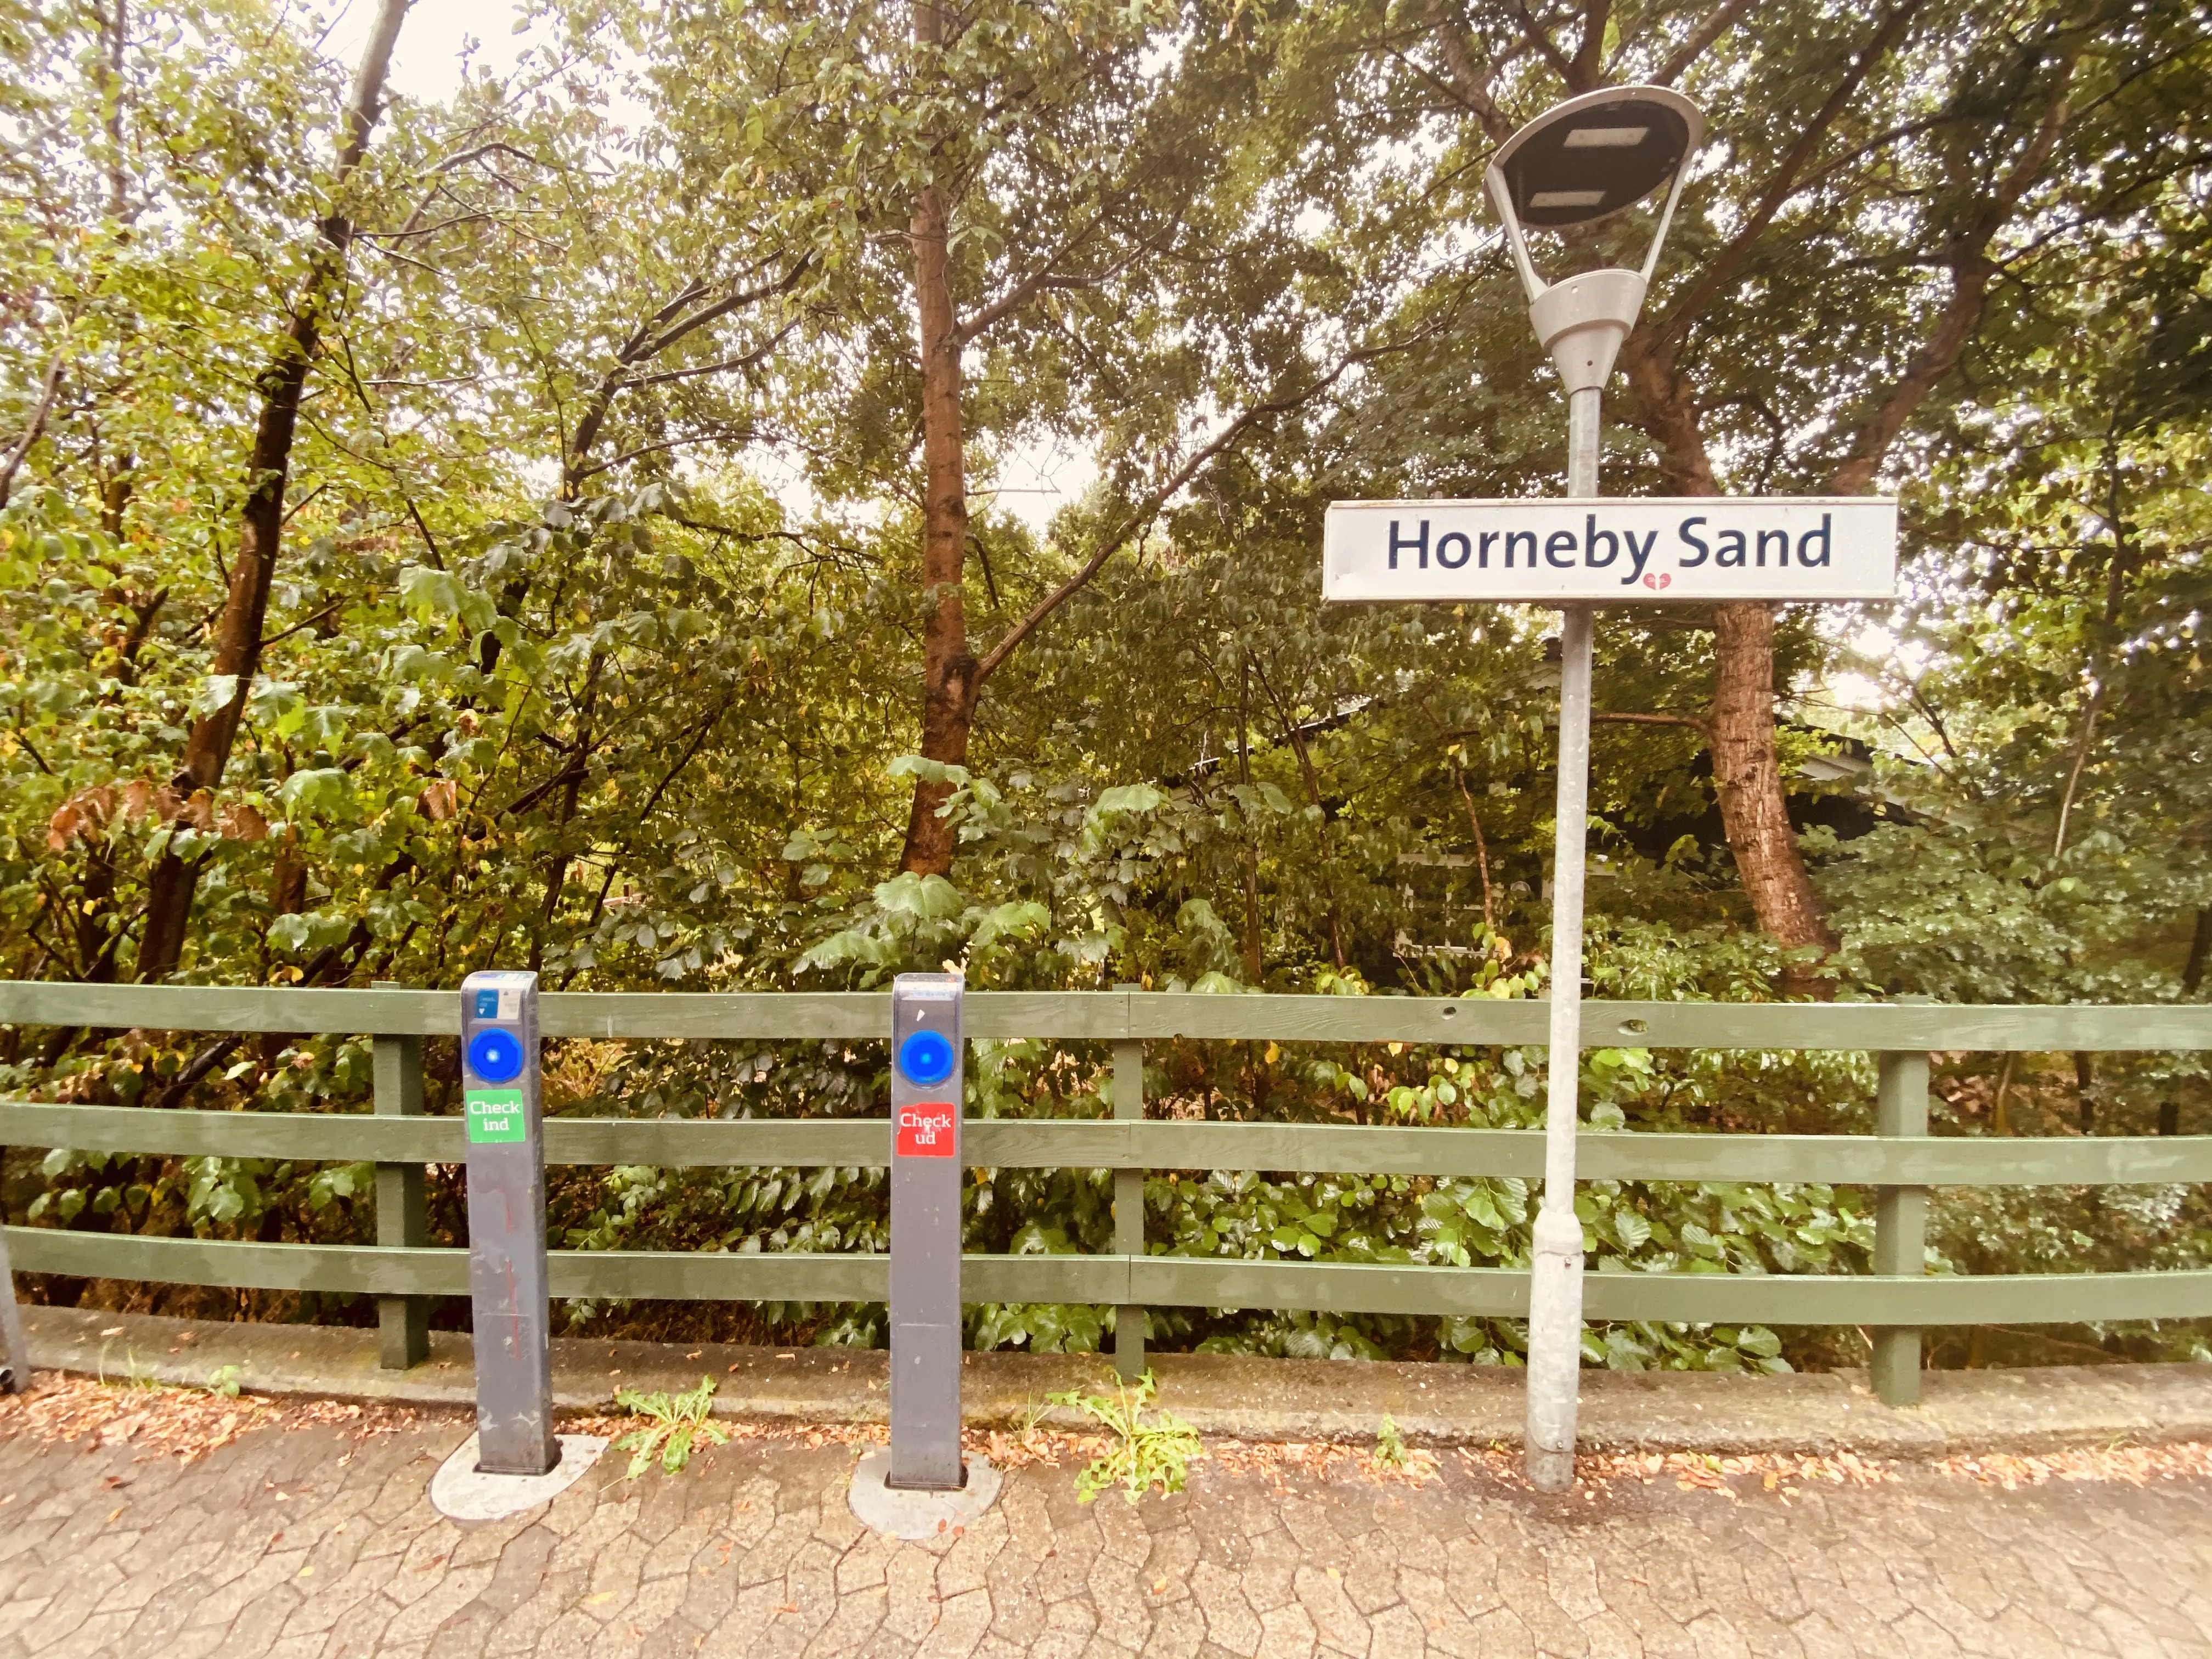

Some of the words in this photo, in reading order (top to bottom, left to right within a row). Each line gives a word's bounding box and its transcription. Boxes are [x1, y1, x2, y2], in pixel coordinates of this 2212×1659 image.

[1387, 513, 1658, 585] Horneby
[1678, 513, 1831, 568] Sand
[470, 1101, 521, 1114] Check
[484, 1118, 509, 1131] ind
[900, 1114, 951, 1128] Check
[916, 1132, 936, 1144] ud
